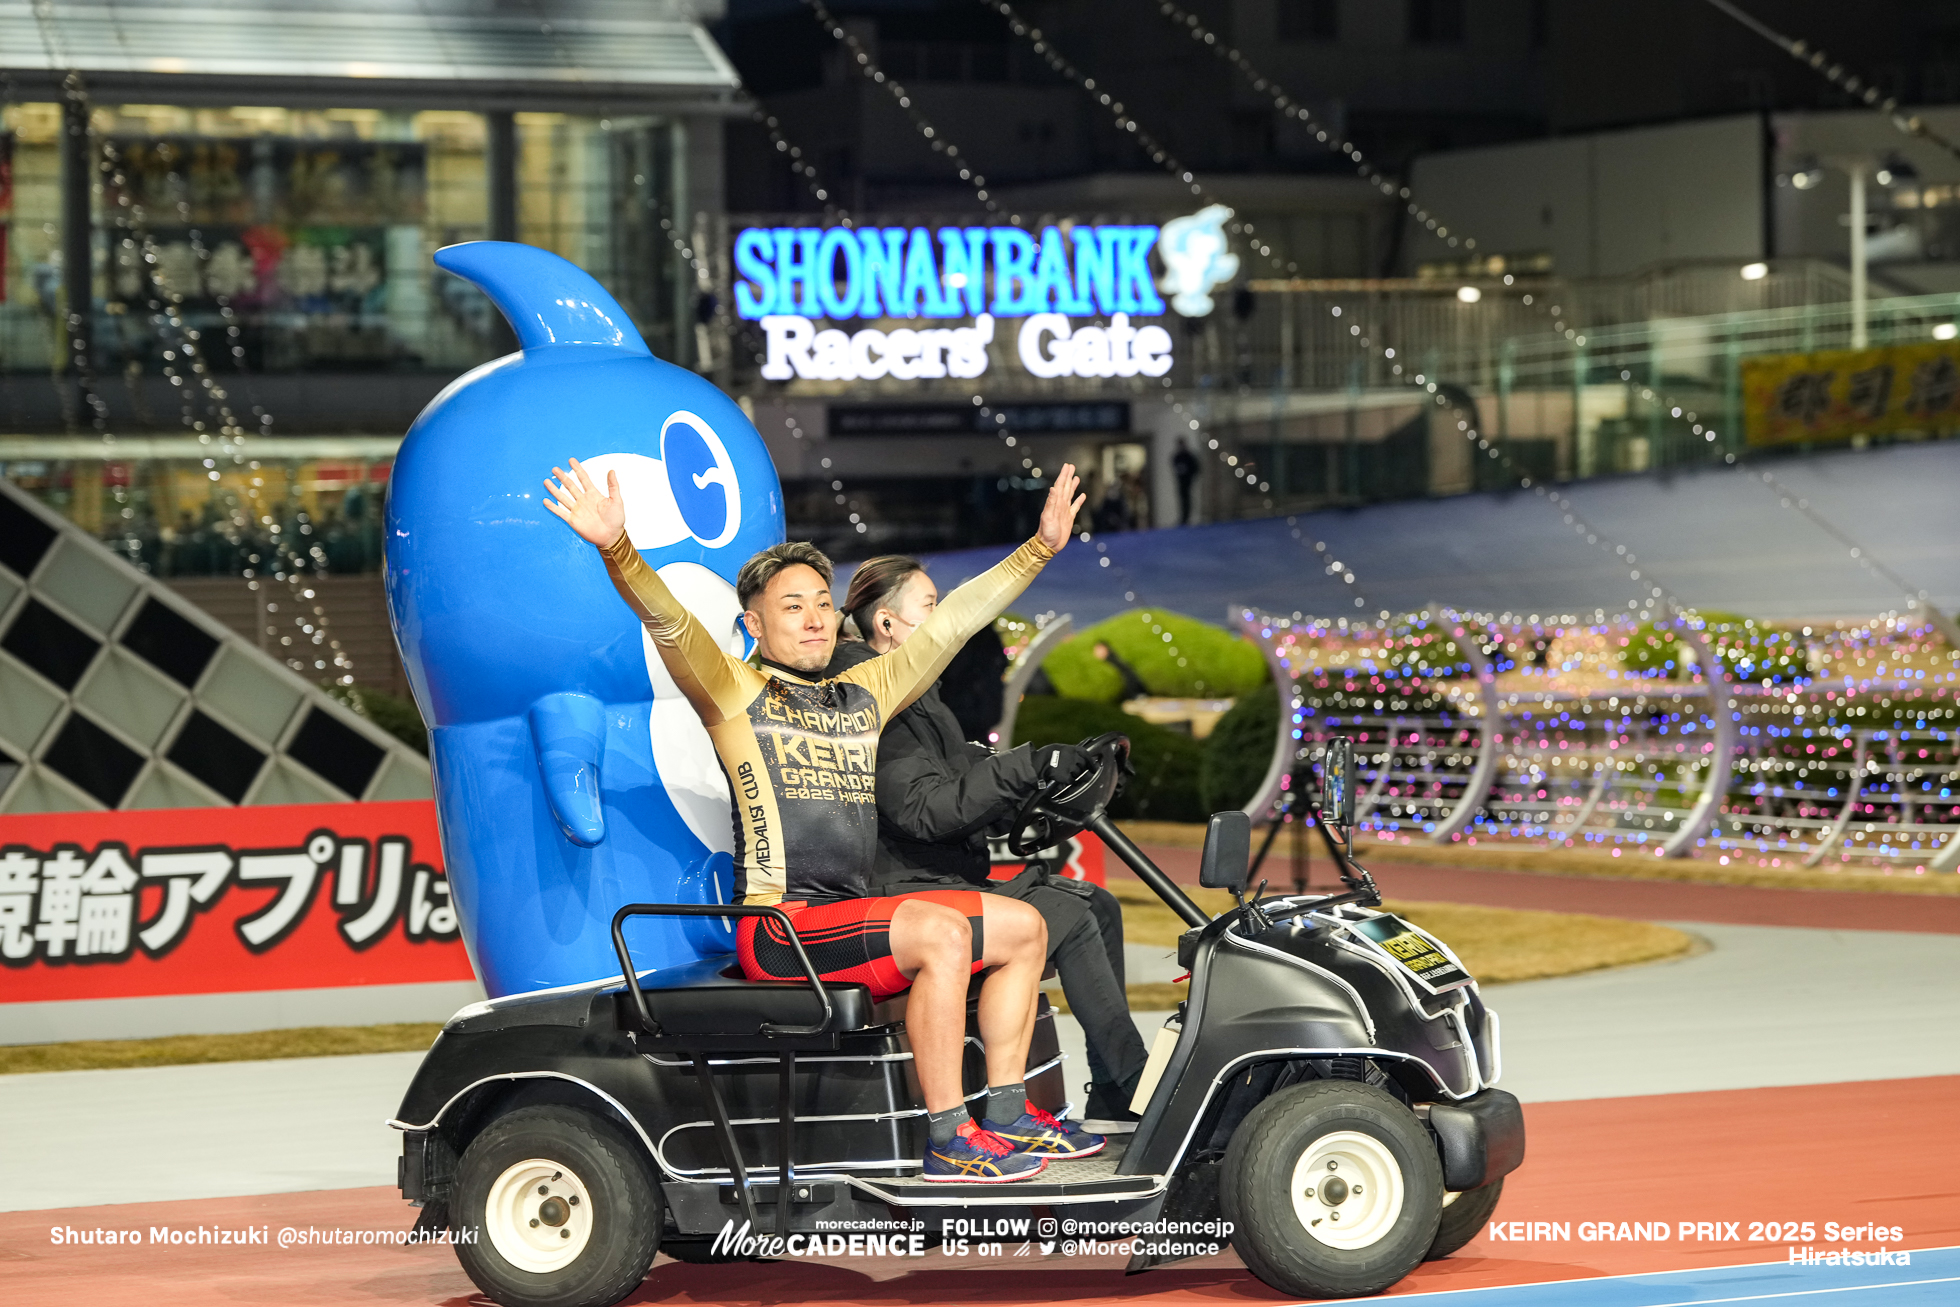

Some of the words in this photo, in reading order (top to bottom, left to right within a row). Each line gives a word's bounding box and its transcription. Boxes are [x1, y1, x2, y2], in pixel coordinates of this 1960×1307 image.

[734, 226, 987, 319] SHONAN
[991, 225, 1165, 315] BANK
[761, 313, 994, 380] Racers'
[1018, 312, 1173, 378] Gate
[765, 697, 877, 732] CHAMPION
[738, 761, 759, 800] CLUB
[781, 767, 862, 791] GRAND
[786, 788, 834, 800] 2025
[749, 805, 771, 876] MEDALIST
